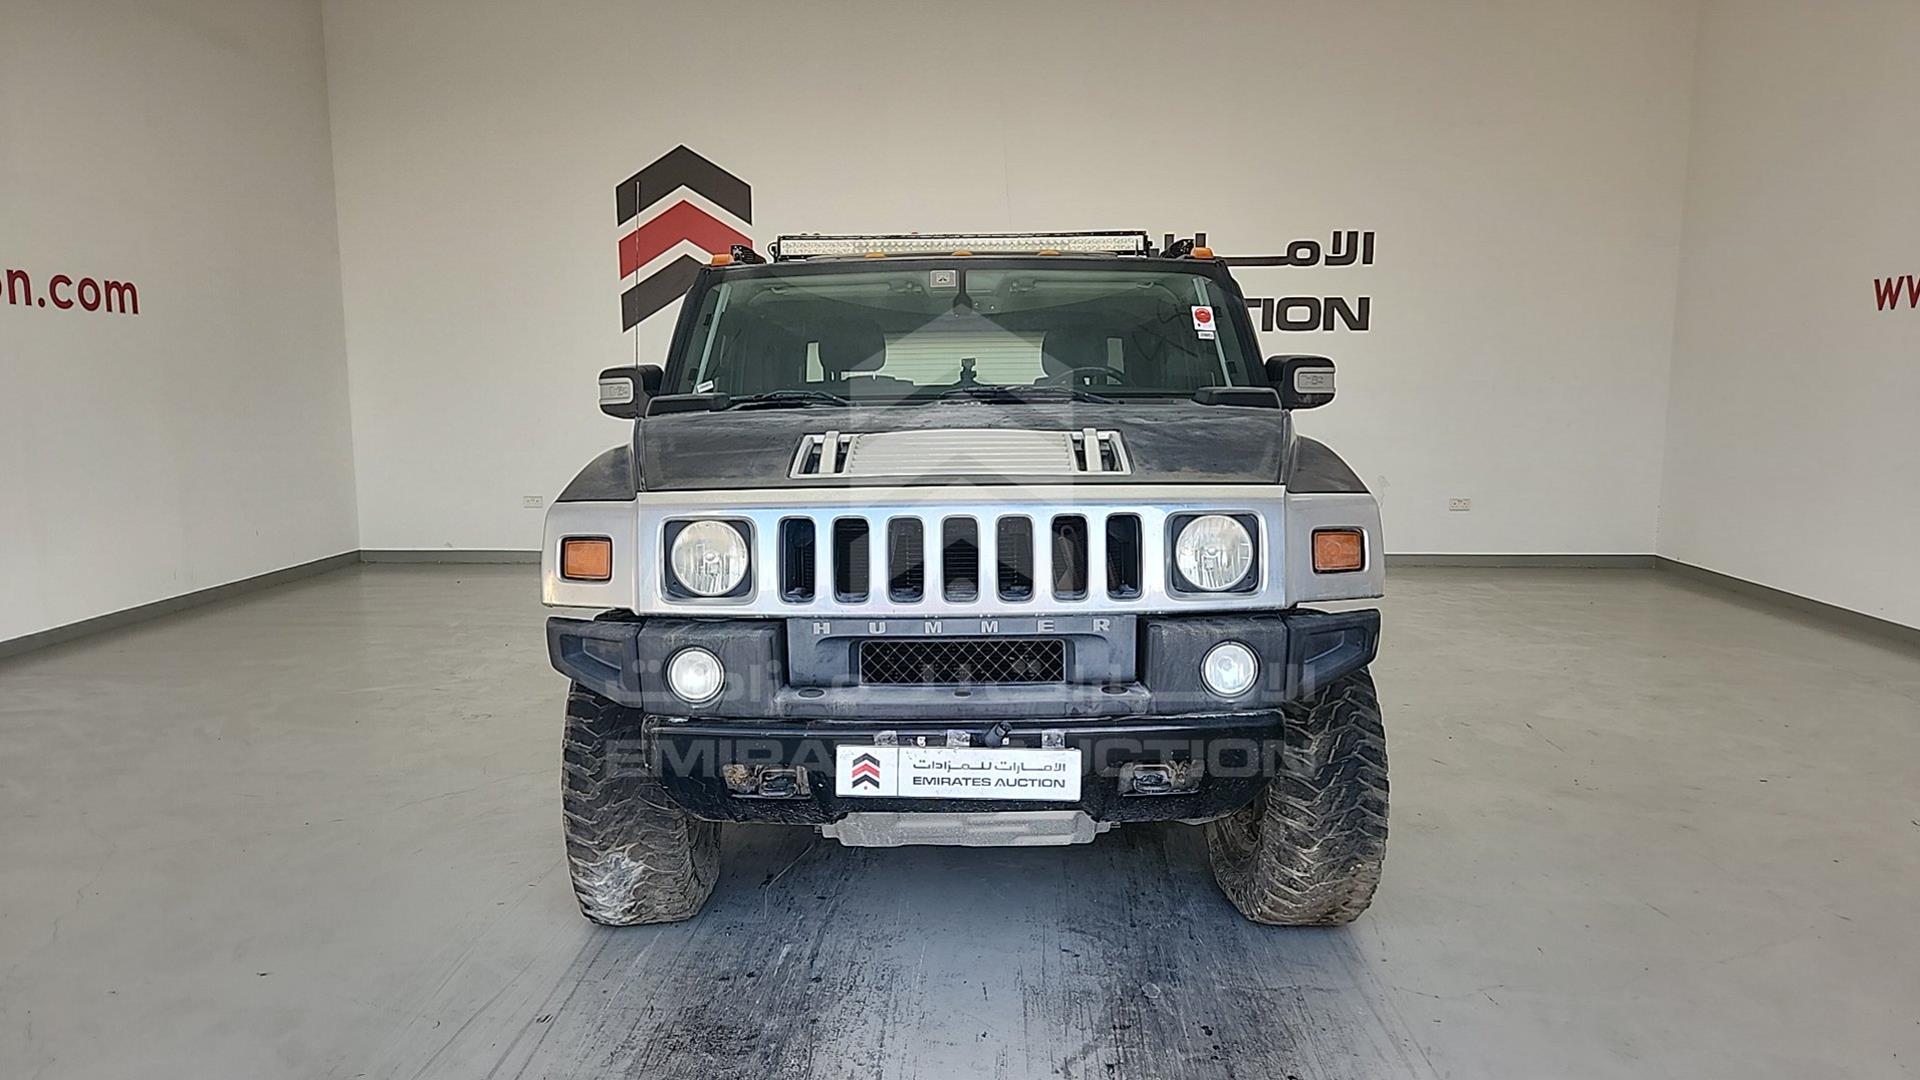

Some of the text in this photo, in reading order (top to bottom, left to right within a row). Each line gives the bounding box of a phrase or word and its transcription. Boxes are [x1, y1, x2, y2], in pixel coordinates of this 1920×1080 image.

[0, 268, 139, 315] n.com
[812, 618, 1112, 635] HUMMER
[912, 776, 1066, 788] EMIRATES AUCTION
